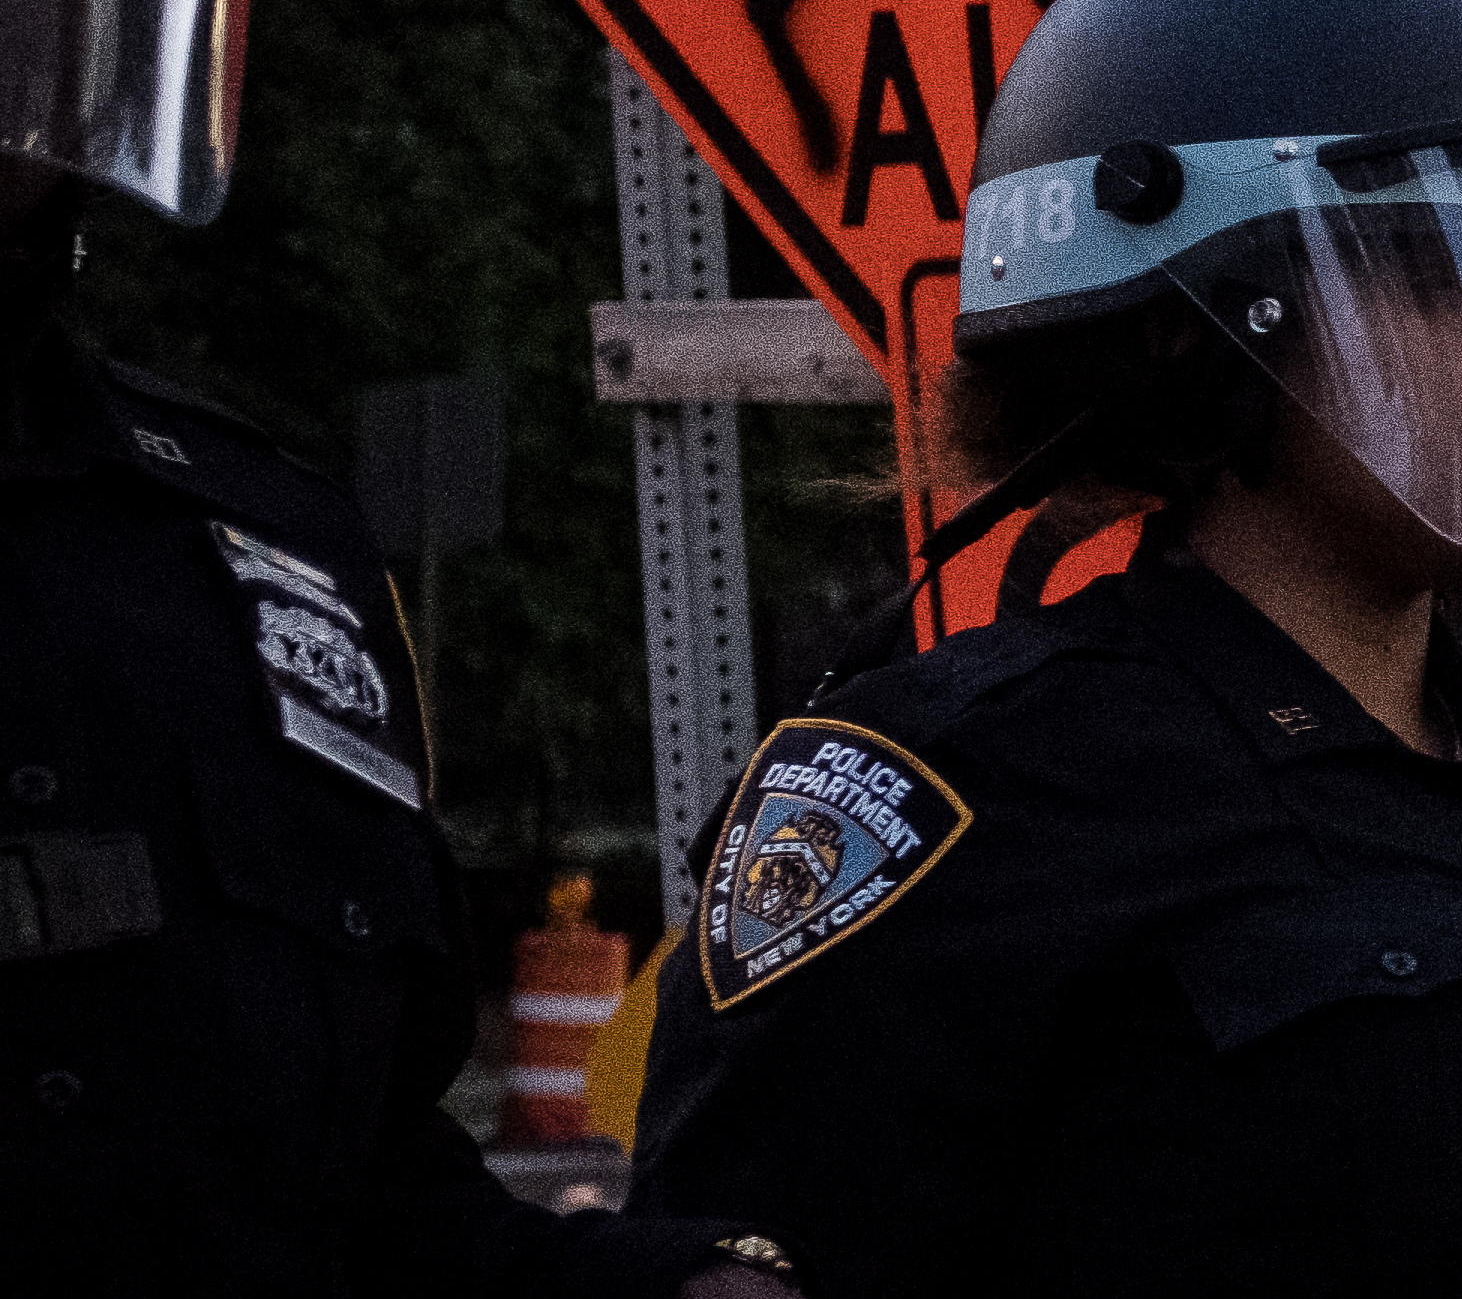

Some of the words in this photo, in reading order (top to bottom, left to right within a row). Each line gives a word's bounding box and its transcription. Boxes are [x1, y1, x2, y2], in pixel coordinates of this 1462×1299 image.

[811, 741, 914, 806] POLICE
[758, 761, 923, 860] DEPARTMENT
[713, 823, 747, 895] CITY
[710, 903, 728, 945] OF
[745, 931, 805, 980] NEW
[806, 873, 897, 939] YORK
